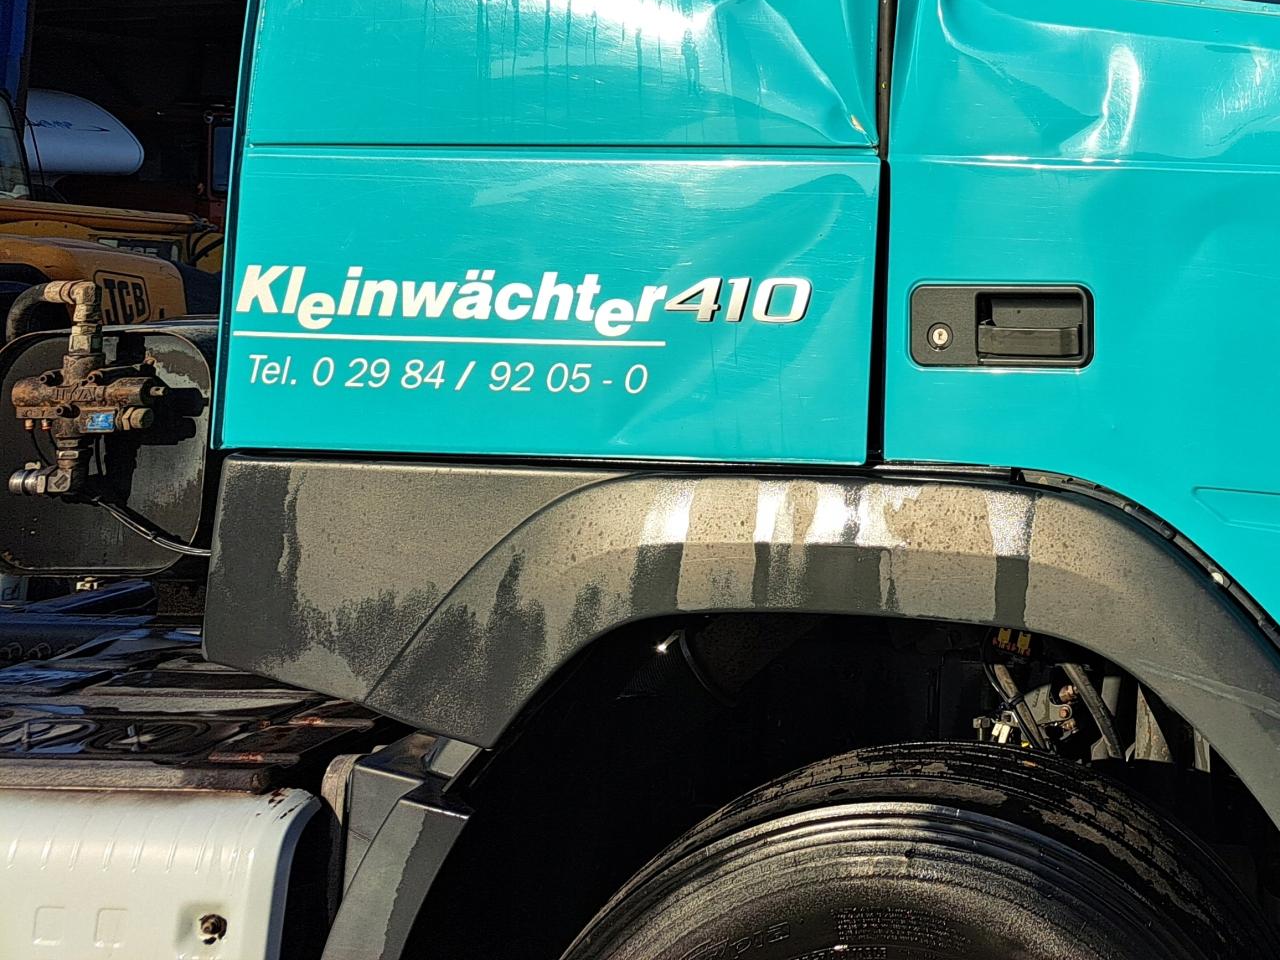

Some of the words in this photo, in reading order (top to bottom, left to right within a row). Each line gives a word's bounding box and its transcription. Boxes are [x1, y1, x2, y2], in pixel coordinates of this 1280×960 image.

[103, 278, 145, 325] JCB
[235, 265, 667, 337] Kleinwächter
[663, 277, 812, 324] 410
[249, 354, 298, 386] Tel.
[312, 356, 335, 387] 0
[344, 357, 390, 388] 29
[400, 359, 445, 390] 84
[488, 361, 535, 392] 92
[545, 362, 592, 393] 05
[623, 364, 648, 394] 0
